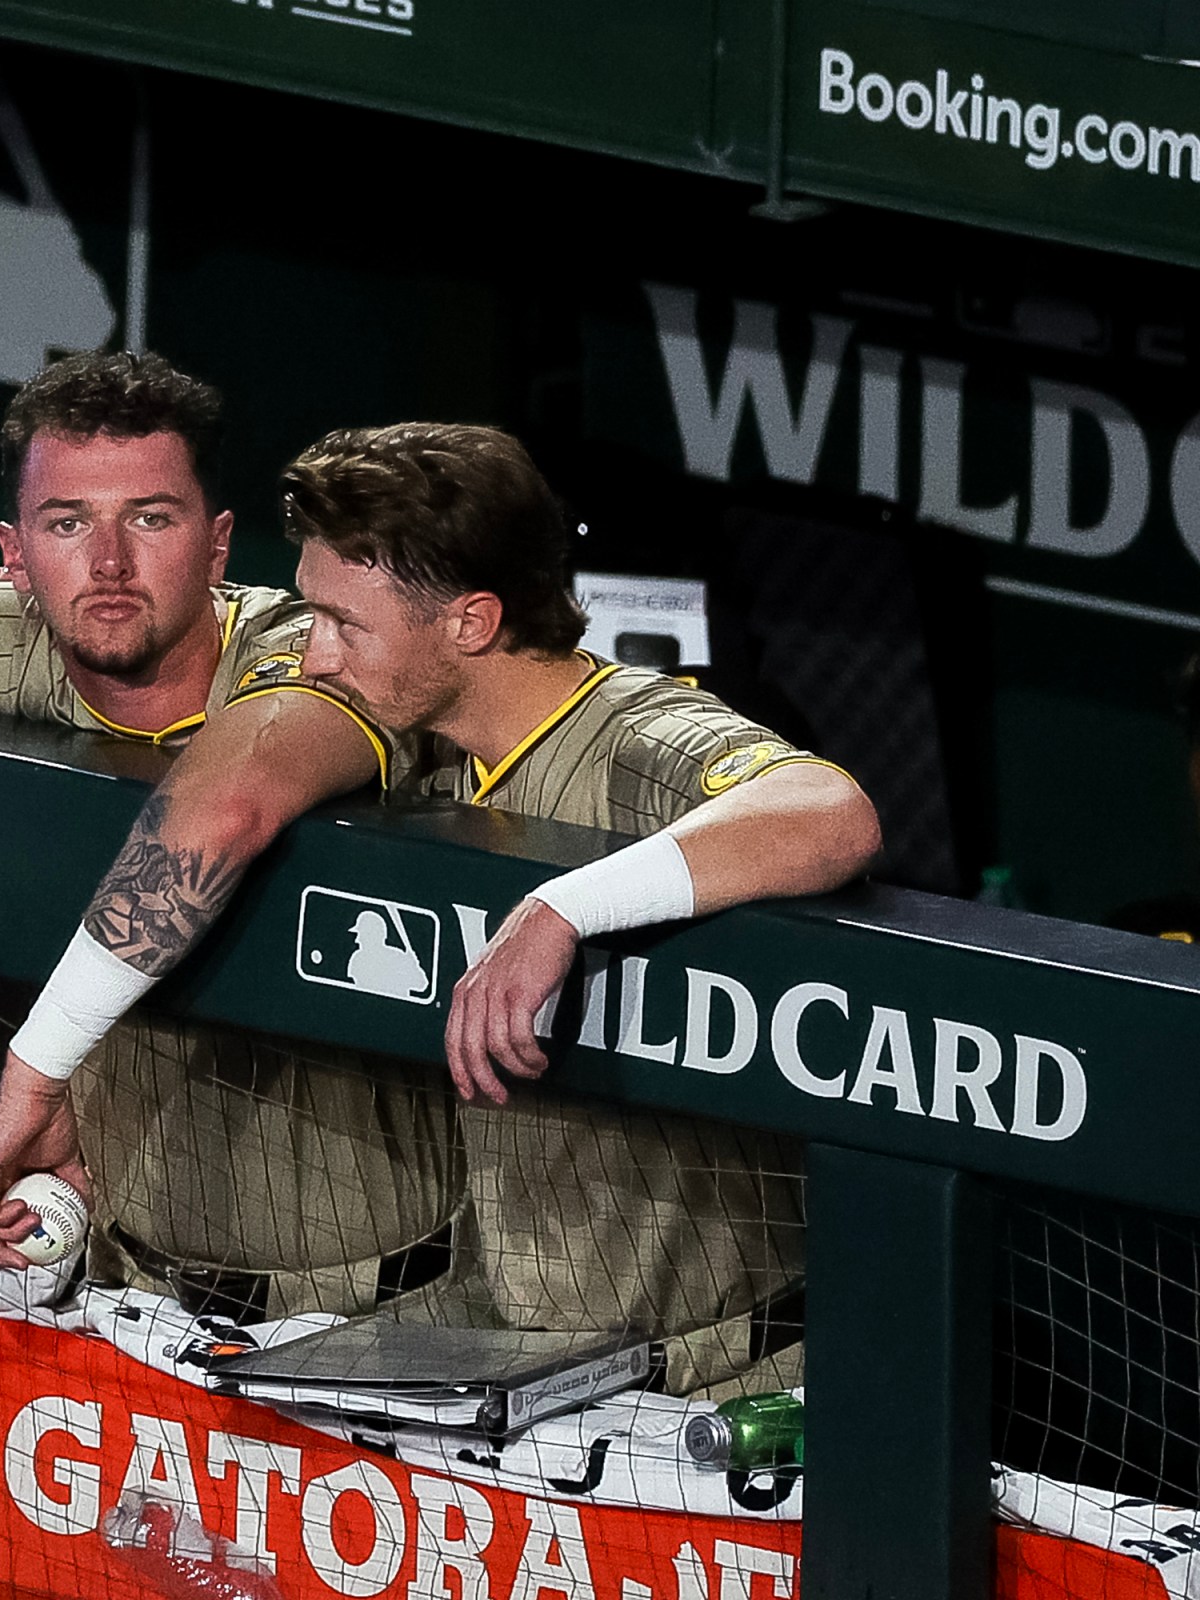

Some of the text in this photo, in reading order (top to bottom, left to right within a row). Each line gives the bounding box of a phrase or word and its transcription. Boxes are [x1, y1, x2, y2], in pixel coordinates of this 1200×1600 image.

[819, 47, 1200, 182] Booking.com
[641, 277, 1200, 572] WILD
[451, 903, 1088, 1141] ILDCARD
[5, 1395, 796, 1600] GATORA
